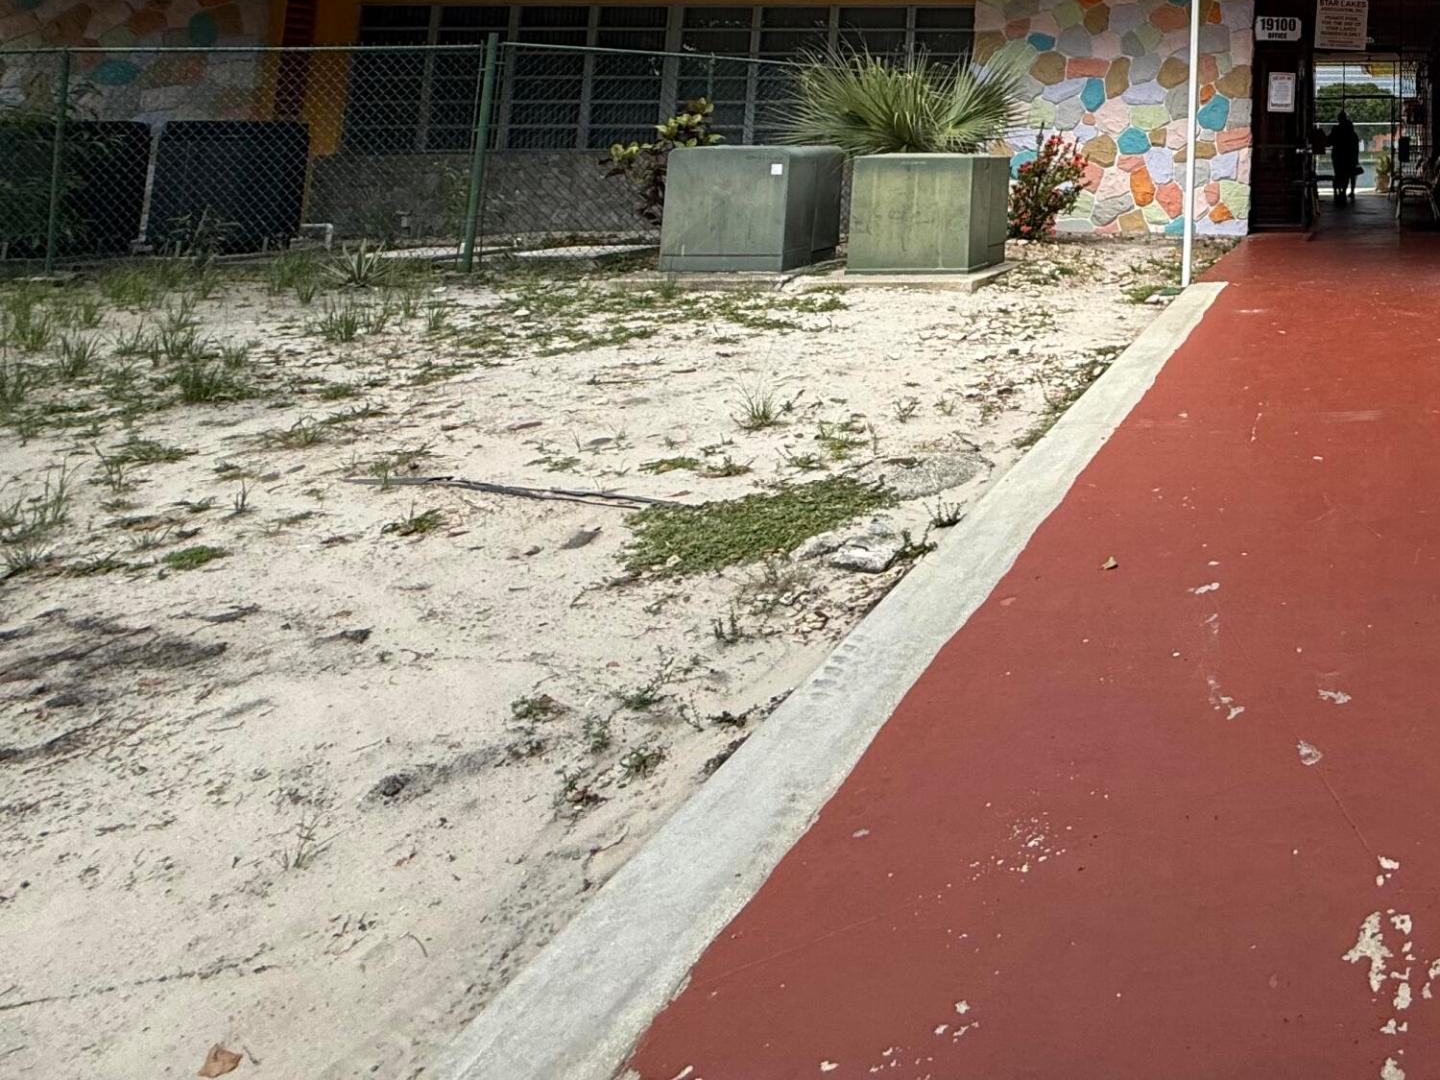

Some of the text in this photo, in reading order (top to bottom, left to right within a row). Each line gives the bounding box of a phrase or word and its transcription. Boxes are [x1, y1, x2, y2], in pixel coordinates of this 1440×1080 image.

[1320, 0, 1367, 8] STAR LAKES
[1260, 17, 1297, 32] 19100
